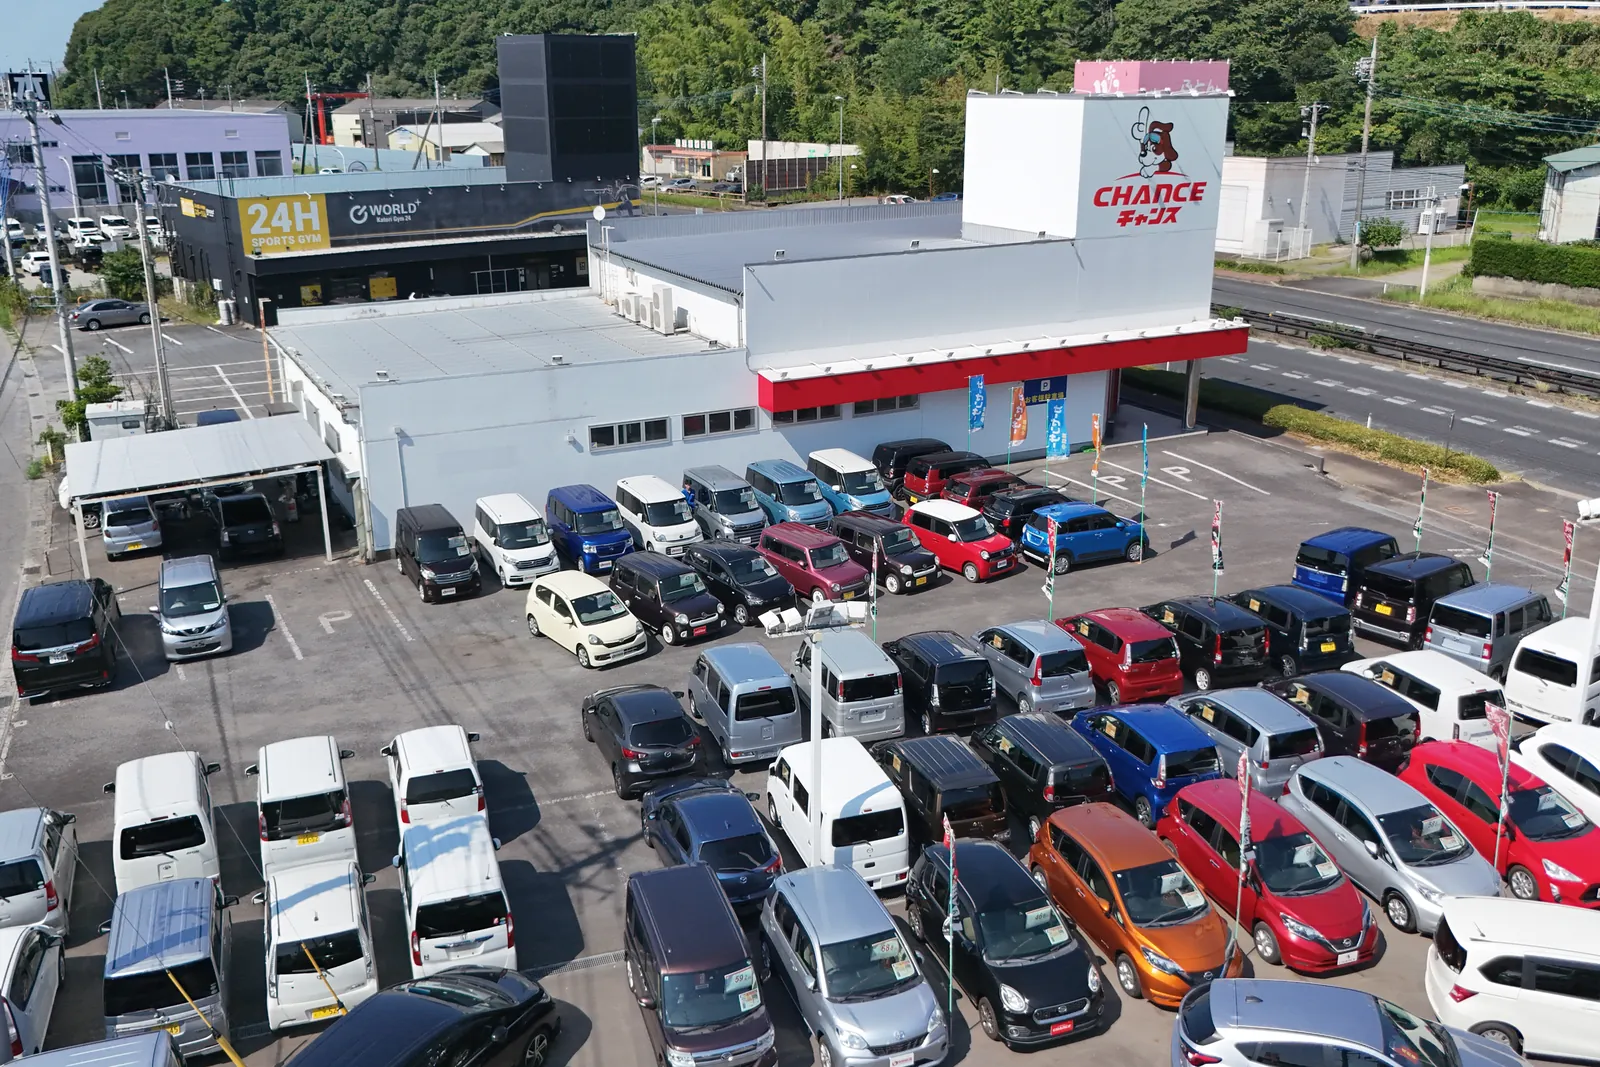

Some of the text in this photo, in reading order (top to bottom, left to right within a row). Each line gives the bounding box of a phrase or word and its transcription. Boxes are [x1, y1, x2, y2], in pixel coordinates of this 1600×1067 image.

[1093, 182, 1207, 208] CHANCE
[247, 200, 321, 235] 24H
[1116, 206, 1182, 228] チャンス
[251, 233, 322, 247] SPORTS GYM
